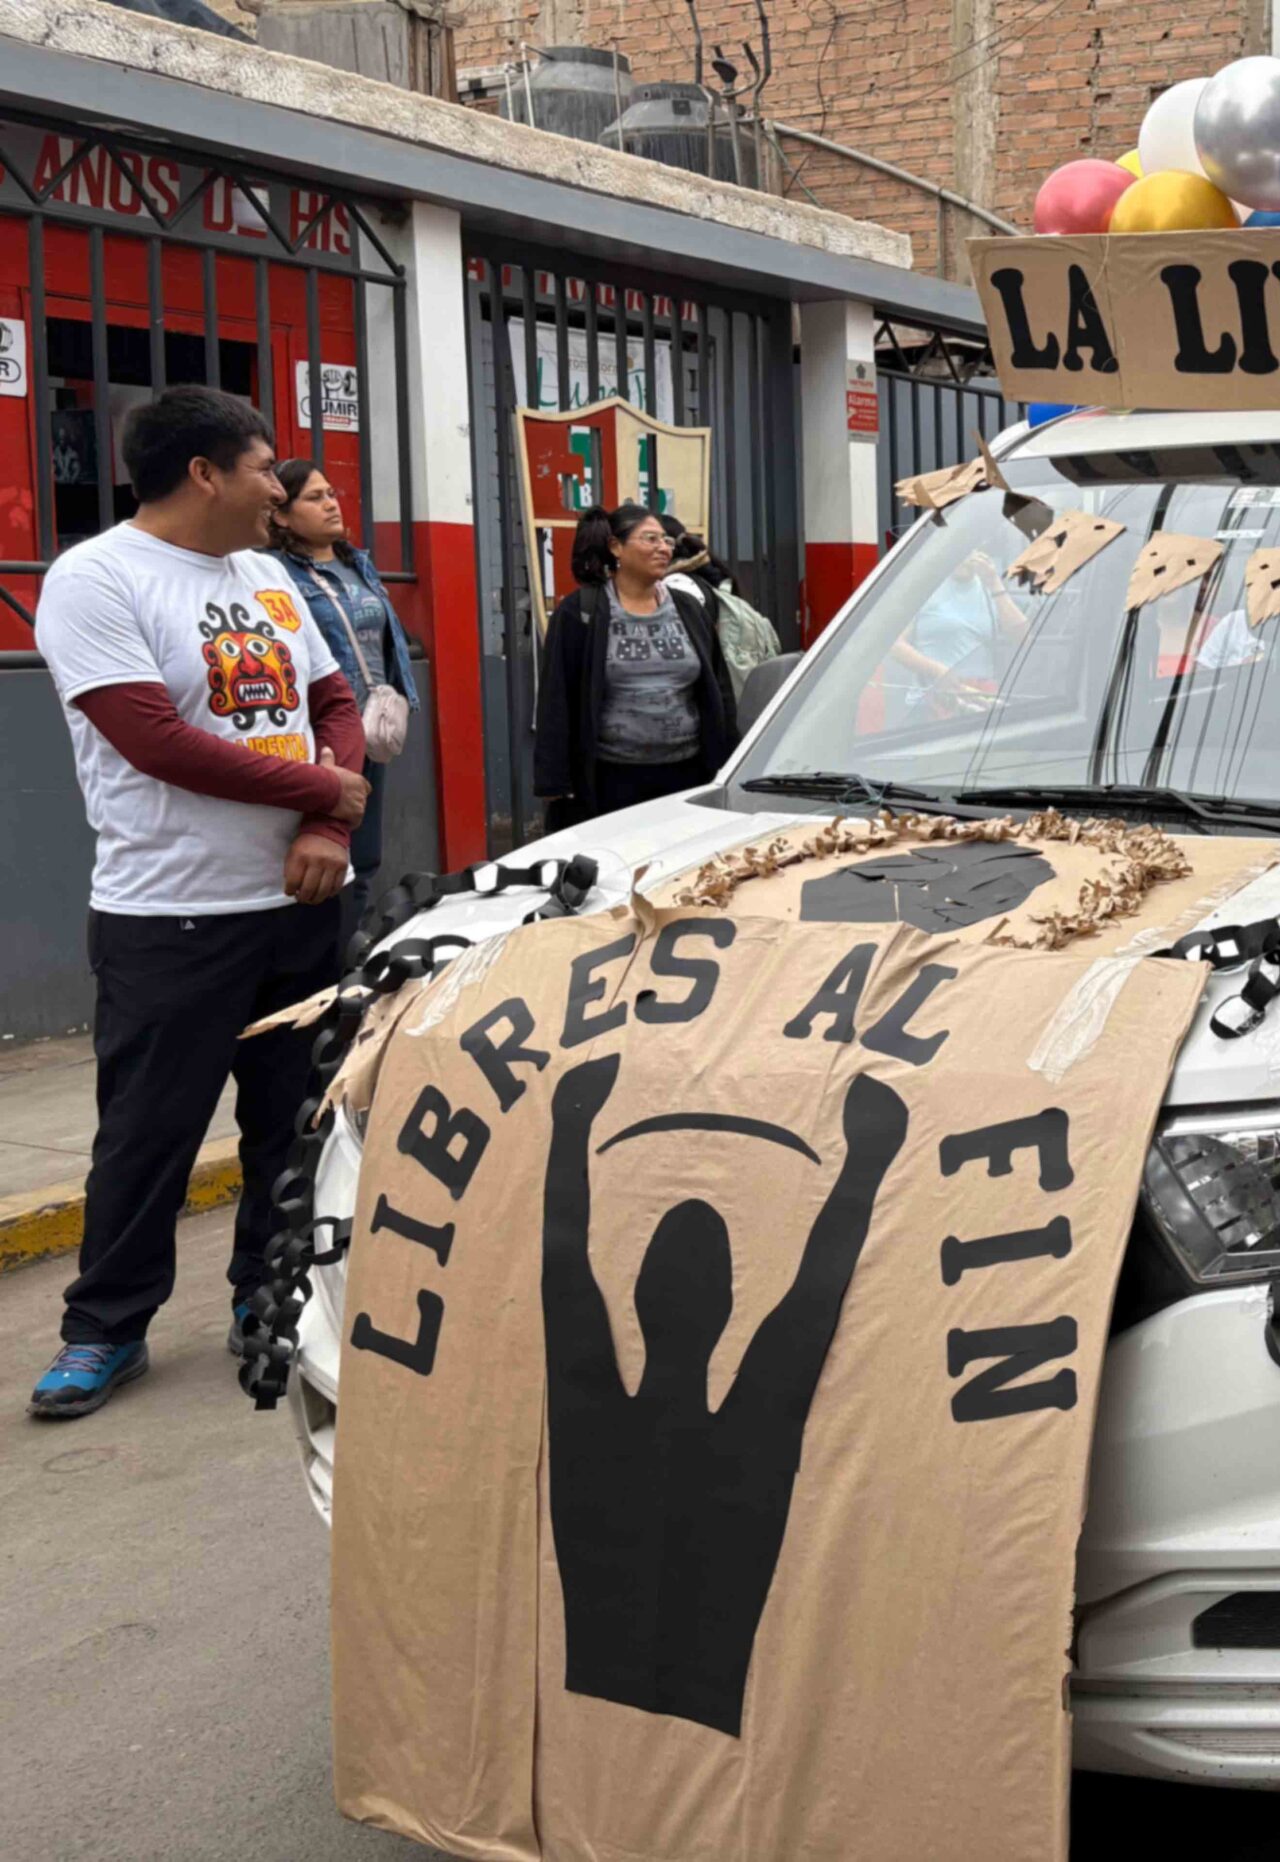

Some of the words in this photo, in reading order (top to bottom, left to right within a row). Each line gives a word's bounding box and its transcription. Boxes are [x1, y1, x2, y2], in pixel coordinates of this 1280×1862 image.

[990, 263, 1119, 374] LA
[321, 400, 359, 417] UMIR
[351, 917, 737, 1377] LIBRES
[783, 942, 959, 1066] AL
[937, 1107, 1079, 1423] FIN
